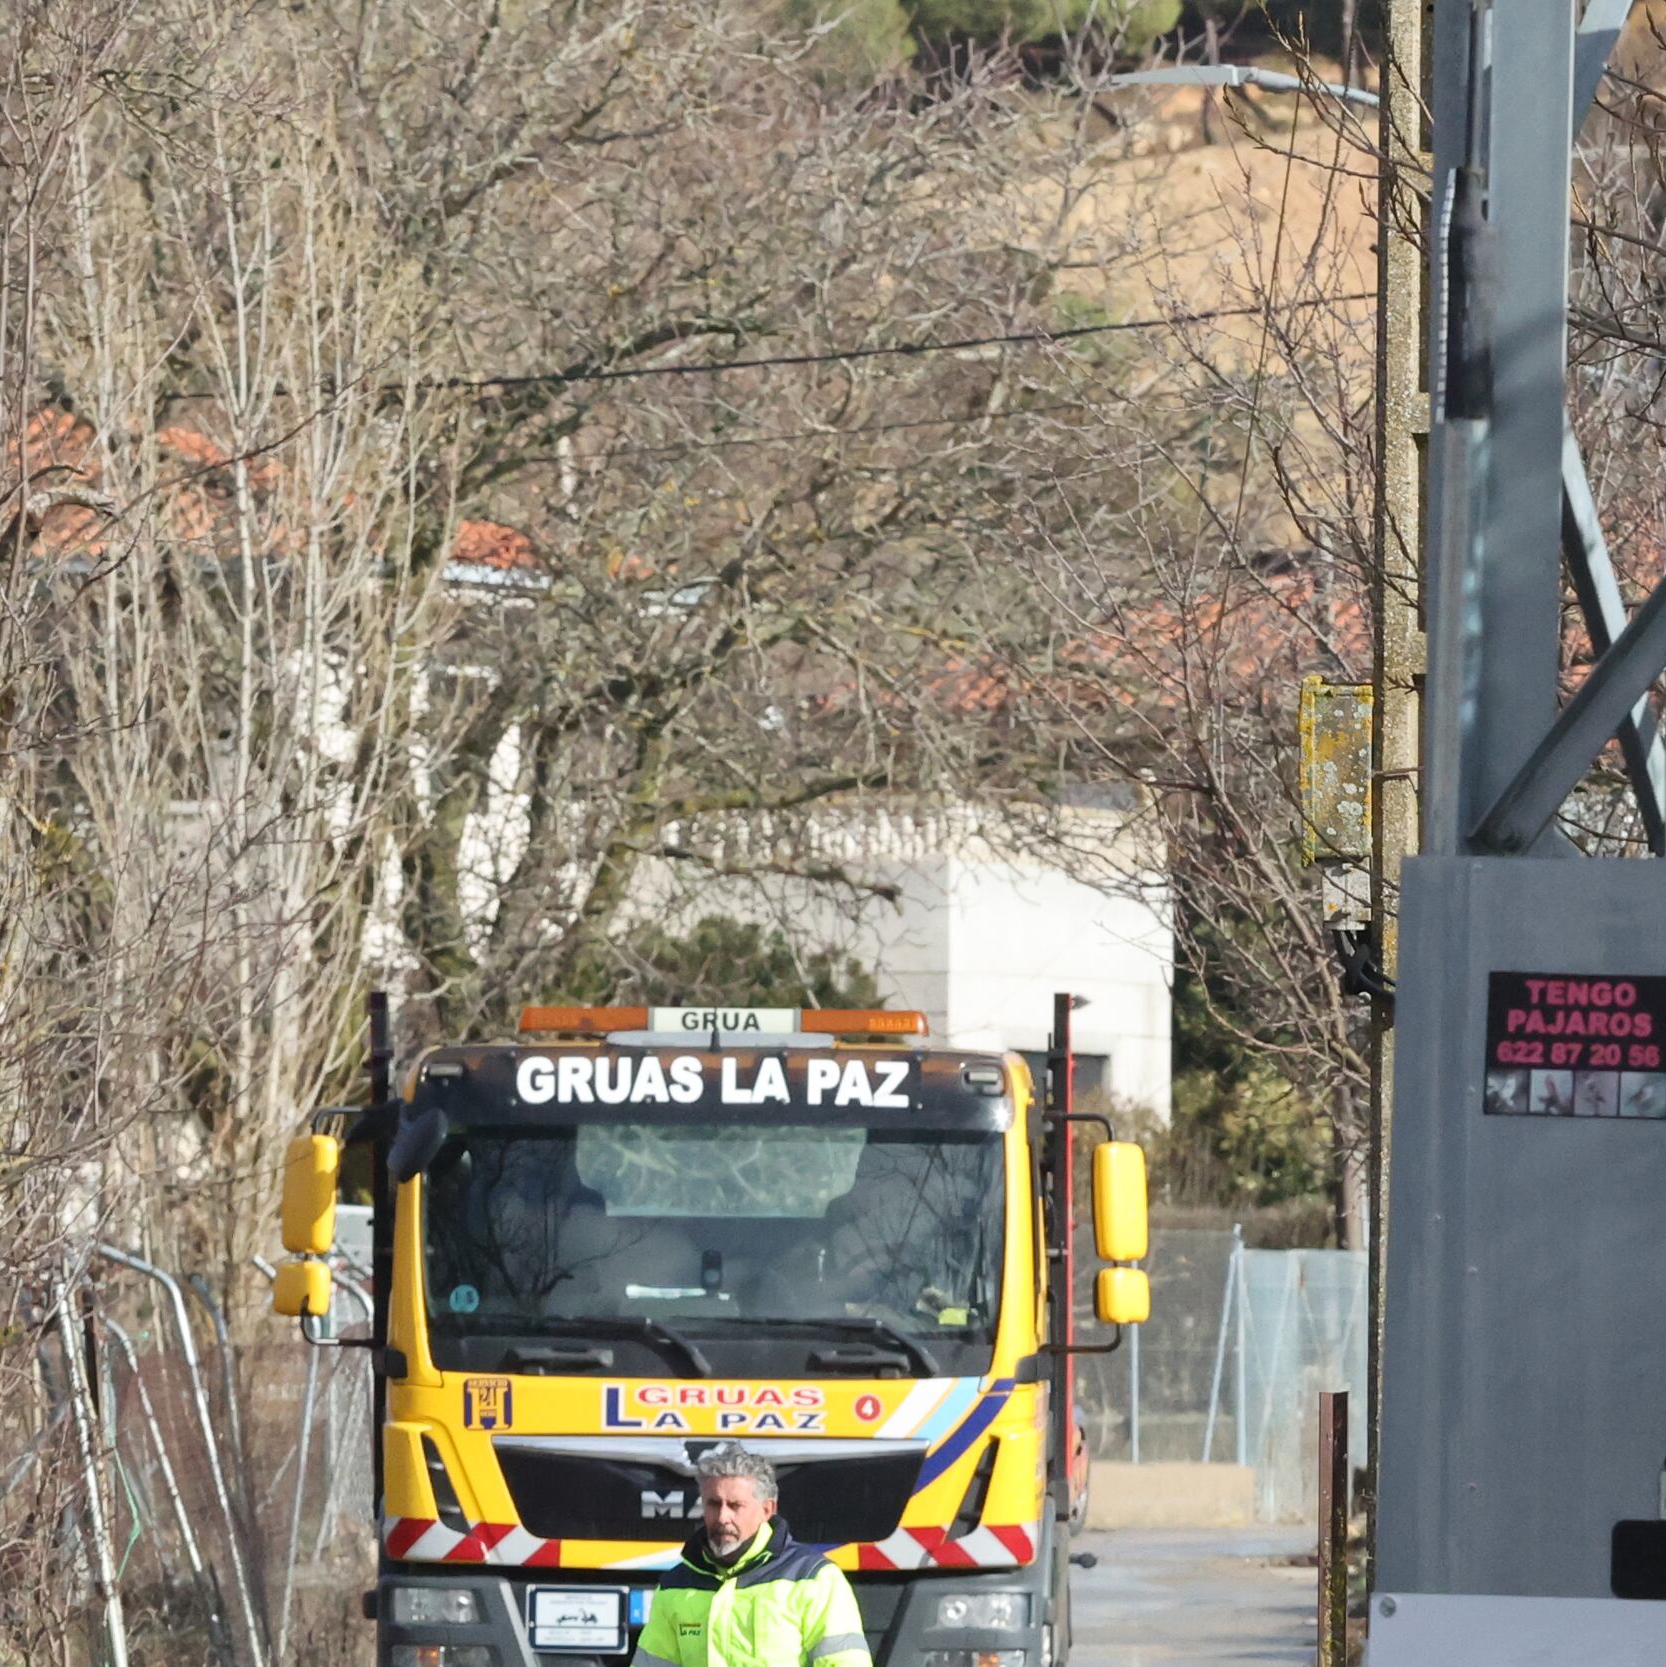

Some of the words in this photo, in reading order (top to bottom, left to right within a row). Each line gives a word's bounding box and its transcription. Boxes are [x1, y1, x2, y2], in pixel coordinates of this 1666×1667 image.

[1526, 979, 1637, 1007] TENGO
[682, 1011, 761, 1031] GRUA
[1507, 1008, 1653, 1038] PAJAROS
[1496, 1040, 1544, 1064] 622
[1550, 1042, 1582, 1064] 87
[1589, 1043, 1622, 1066] 20
[517, 1056, 704, 1105] GRUAS
[722, 1057, 790, 1105] LA
[808, 1059, 909, 1108] PAZ
[606, 1387, 683, 1428] LA
[720, 1413, 823, 1429] PAZ
[638, 1387, 822, 1406] GRUAS
[862, 1401, 874, 1416] 4
